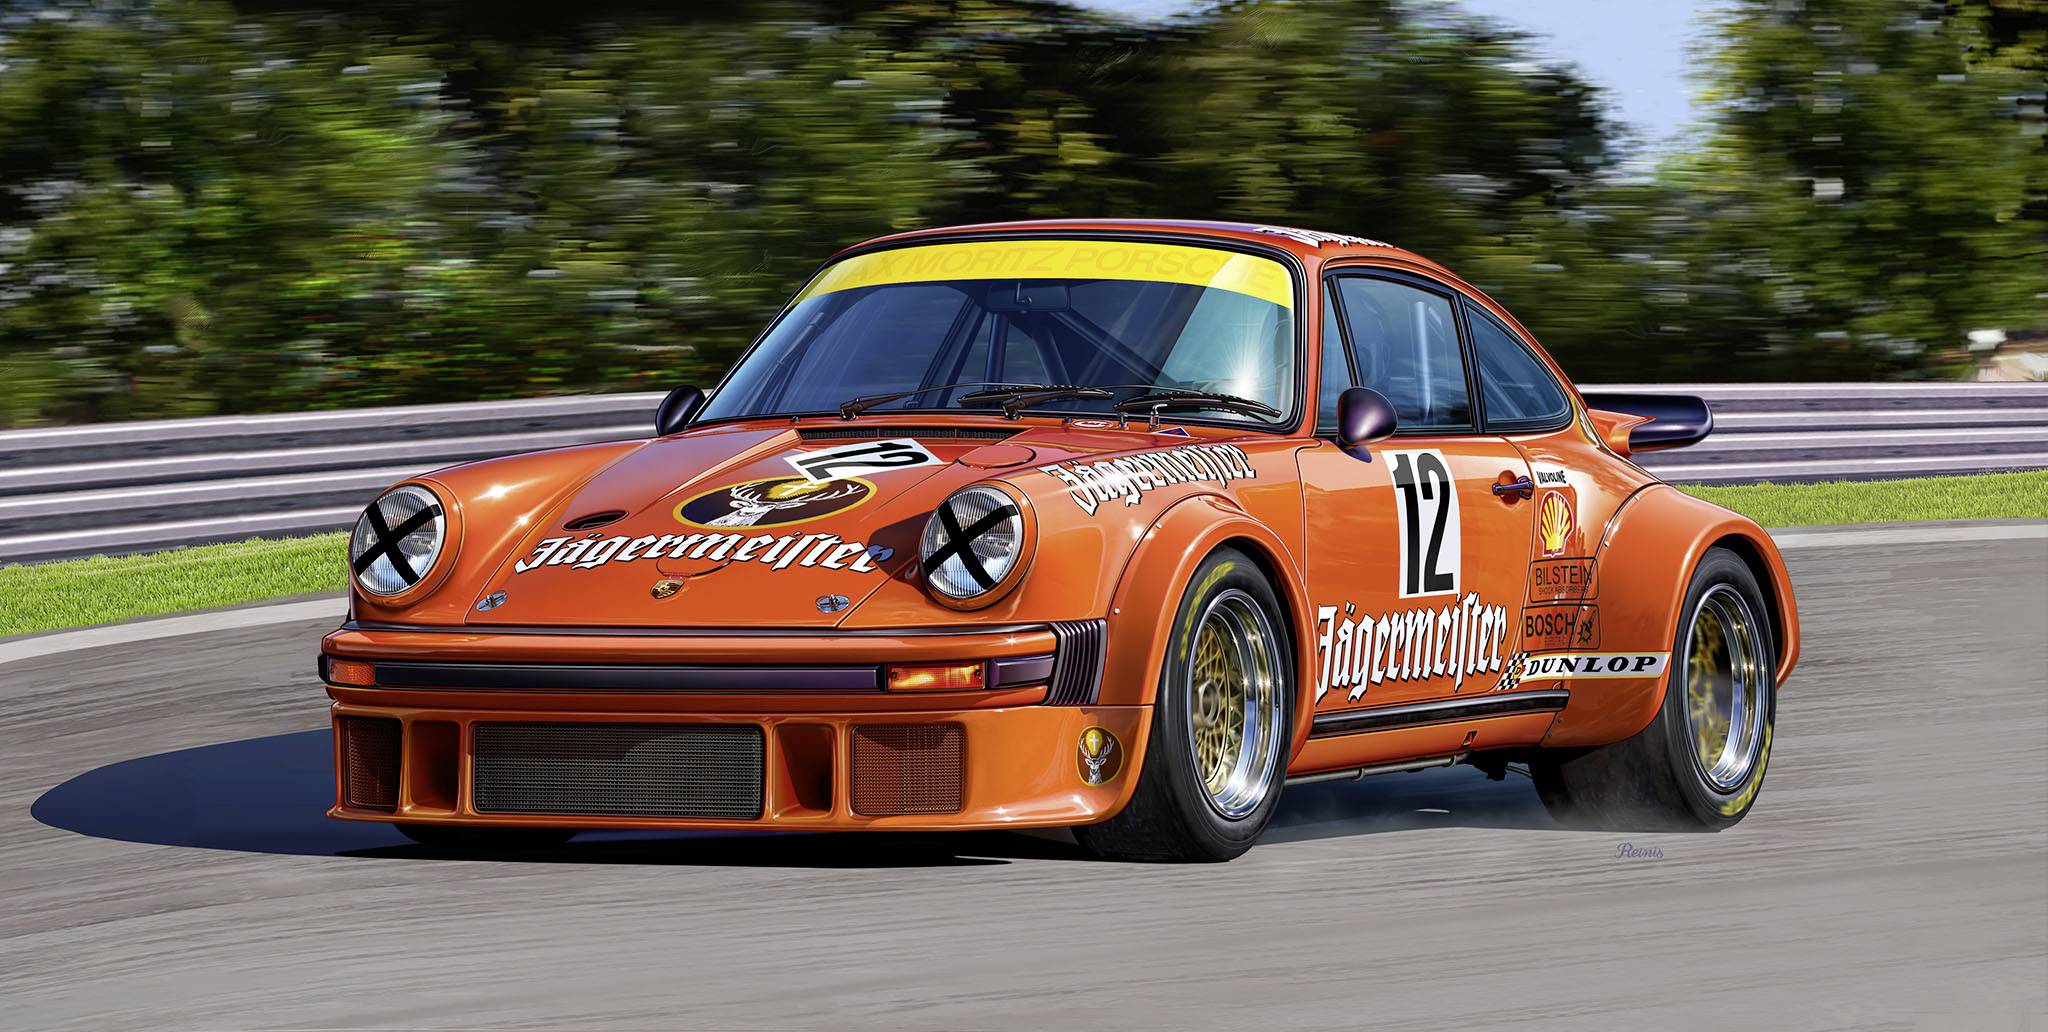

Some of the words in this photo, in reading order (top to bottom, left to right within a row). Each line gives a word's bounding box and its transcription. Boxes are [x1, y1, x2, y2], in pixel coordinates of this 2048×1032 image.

[901, 246, 1065, 275] MORITZ
[1063, 246, 1281, 290] PORSCHE
[796, 441, 929, 480] 12
[1536, 469, 1567, 484] VALVOLINE
[1391, 452, 1455, 595] 12
[1535, 565, 1592, 586] BILSTEIN
[1525, 612, 1576, 638] BOSCH
[1527, 656, 1657, 677] DUNLOP
